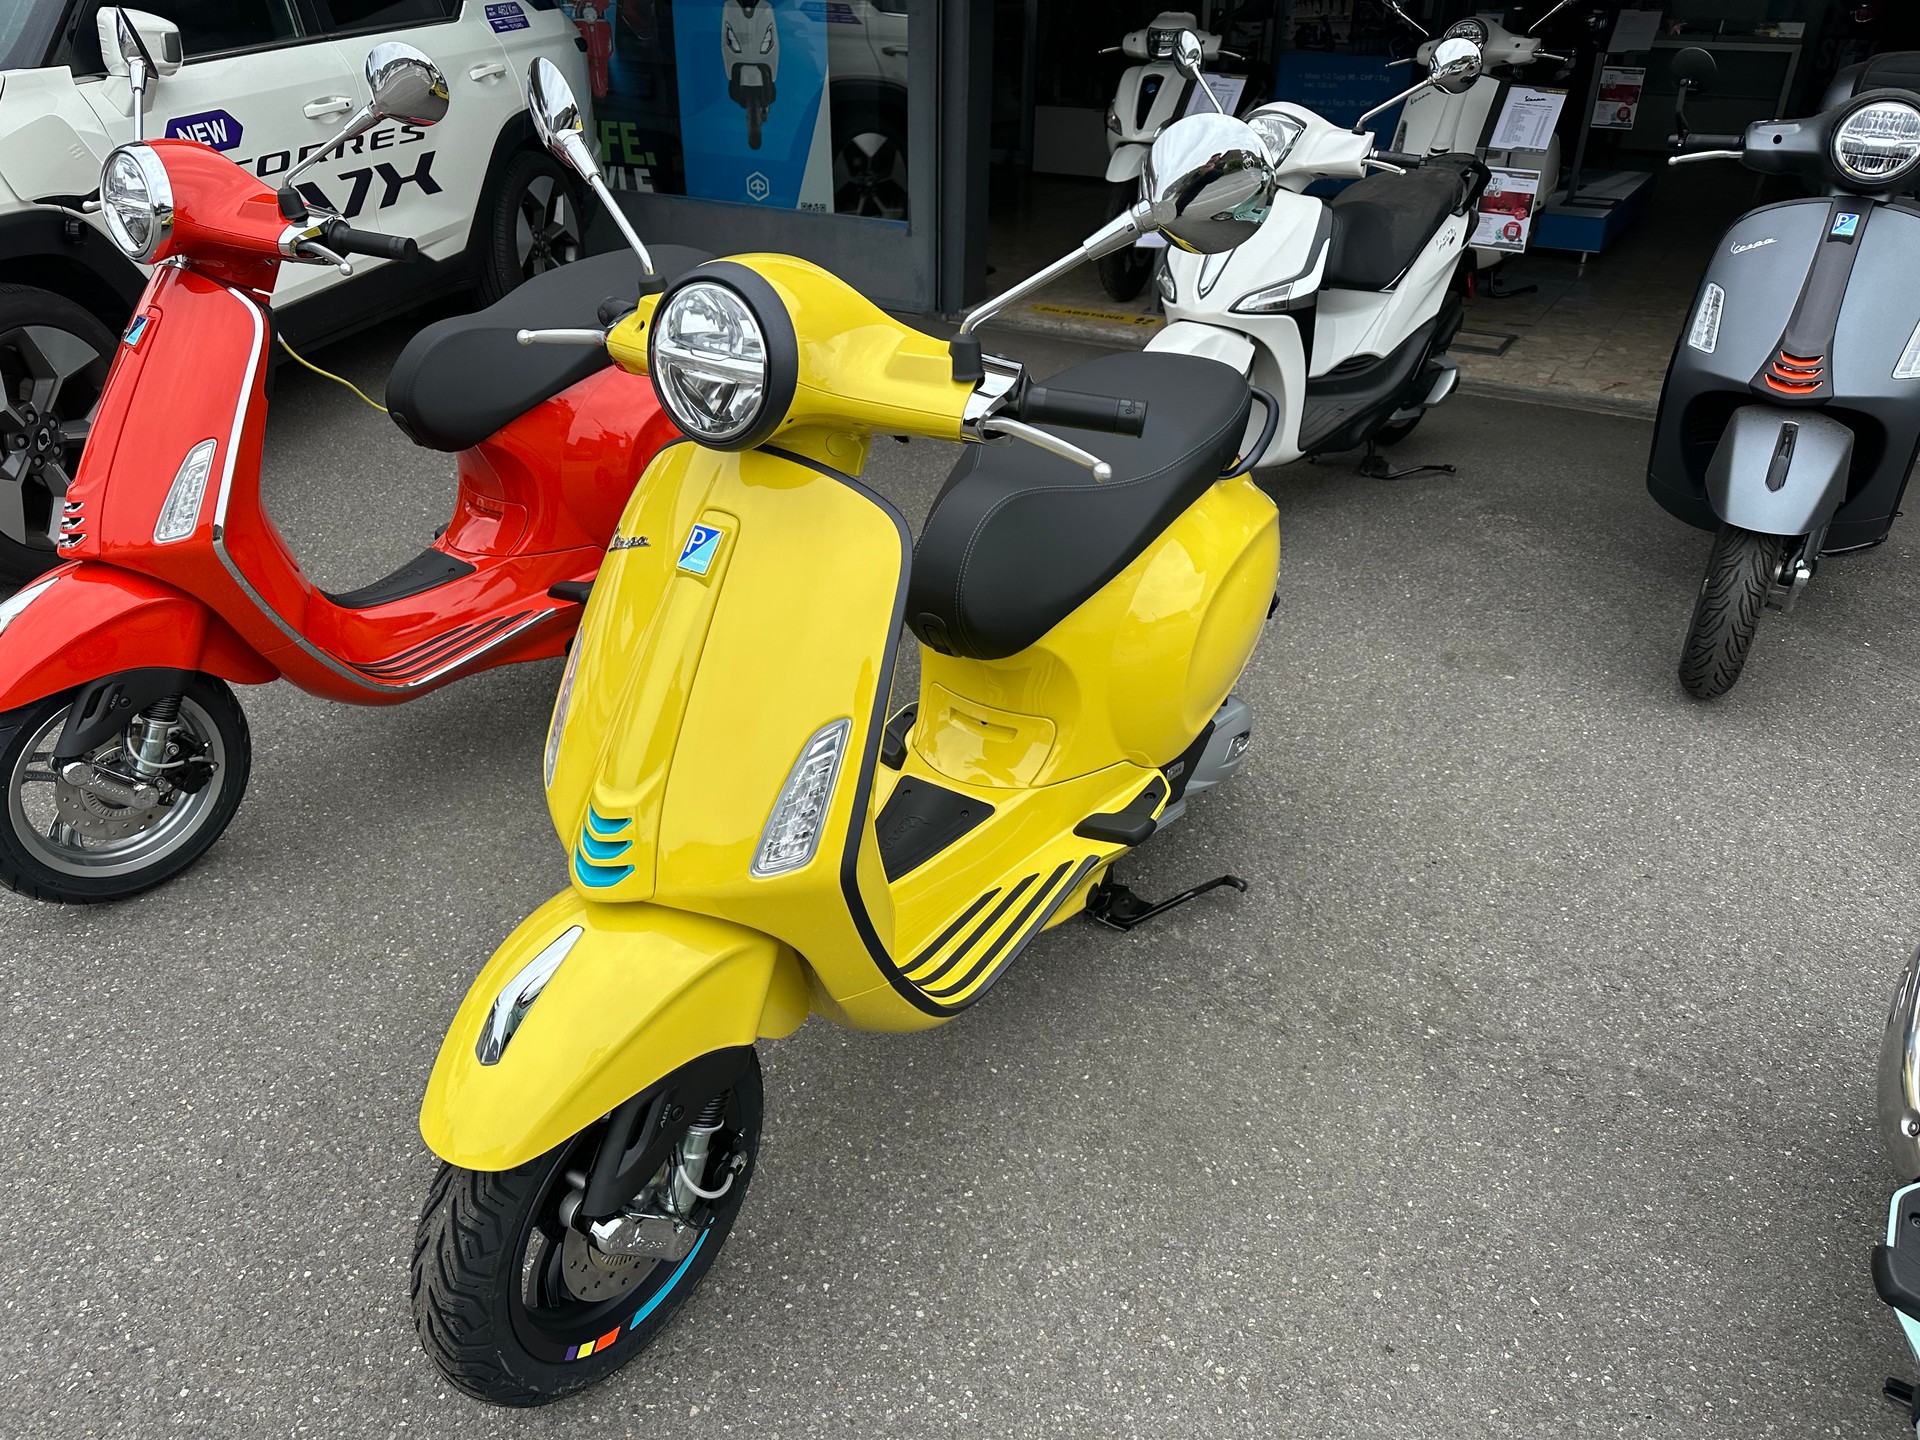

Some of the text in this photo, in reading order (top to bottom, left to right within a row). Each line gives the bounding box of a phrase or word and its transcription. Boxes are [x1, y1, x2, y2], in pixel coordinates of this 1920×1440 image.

[176, 118, 228, 146] NEW
[236, 124, 425, 178] ORRES
[1727, 236, 1778, 257] Vespa
[1062, 308, 1125, 321] ABSTAND
[685, 528, 707, 554] P
[659, 1103, 672, 1129] ABS
